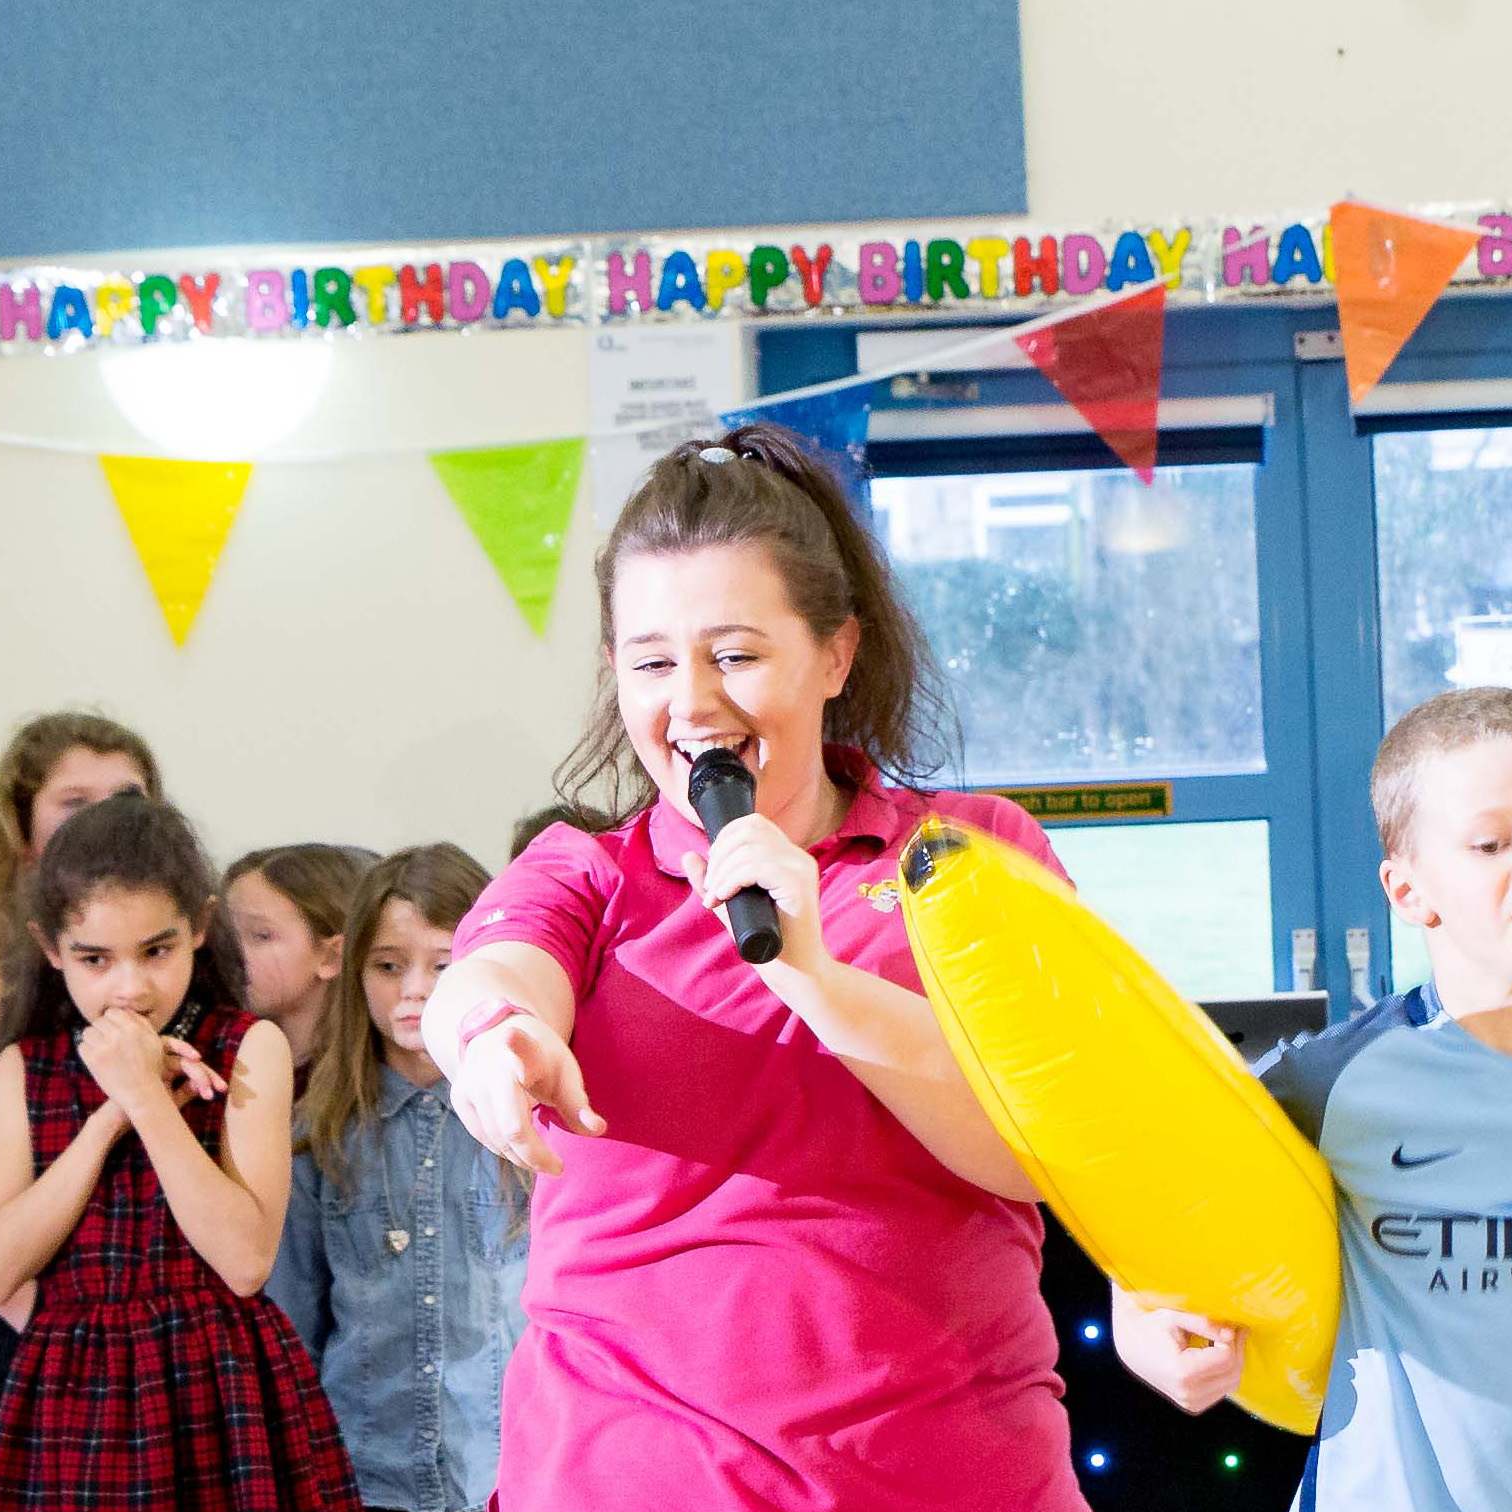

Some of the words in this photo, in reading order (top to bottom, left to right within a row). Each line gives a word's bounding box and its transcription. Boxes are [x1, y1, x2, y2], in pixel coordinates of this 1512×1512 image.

[247, 256, 575, 332] BIRTHDAY
[607, 244, 833, 313] HAPPY
[857, 227, 1191, 306] BIRTHDAY
